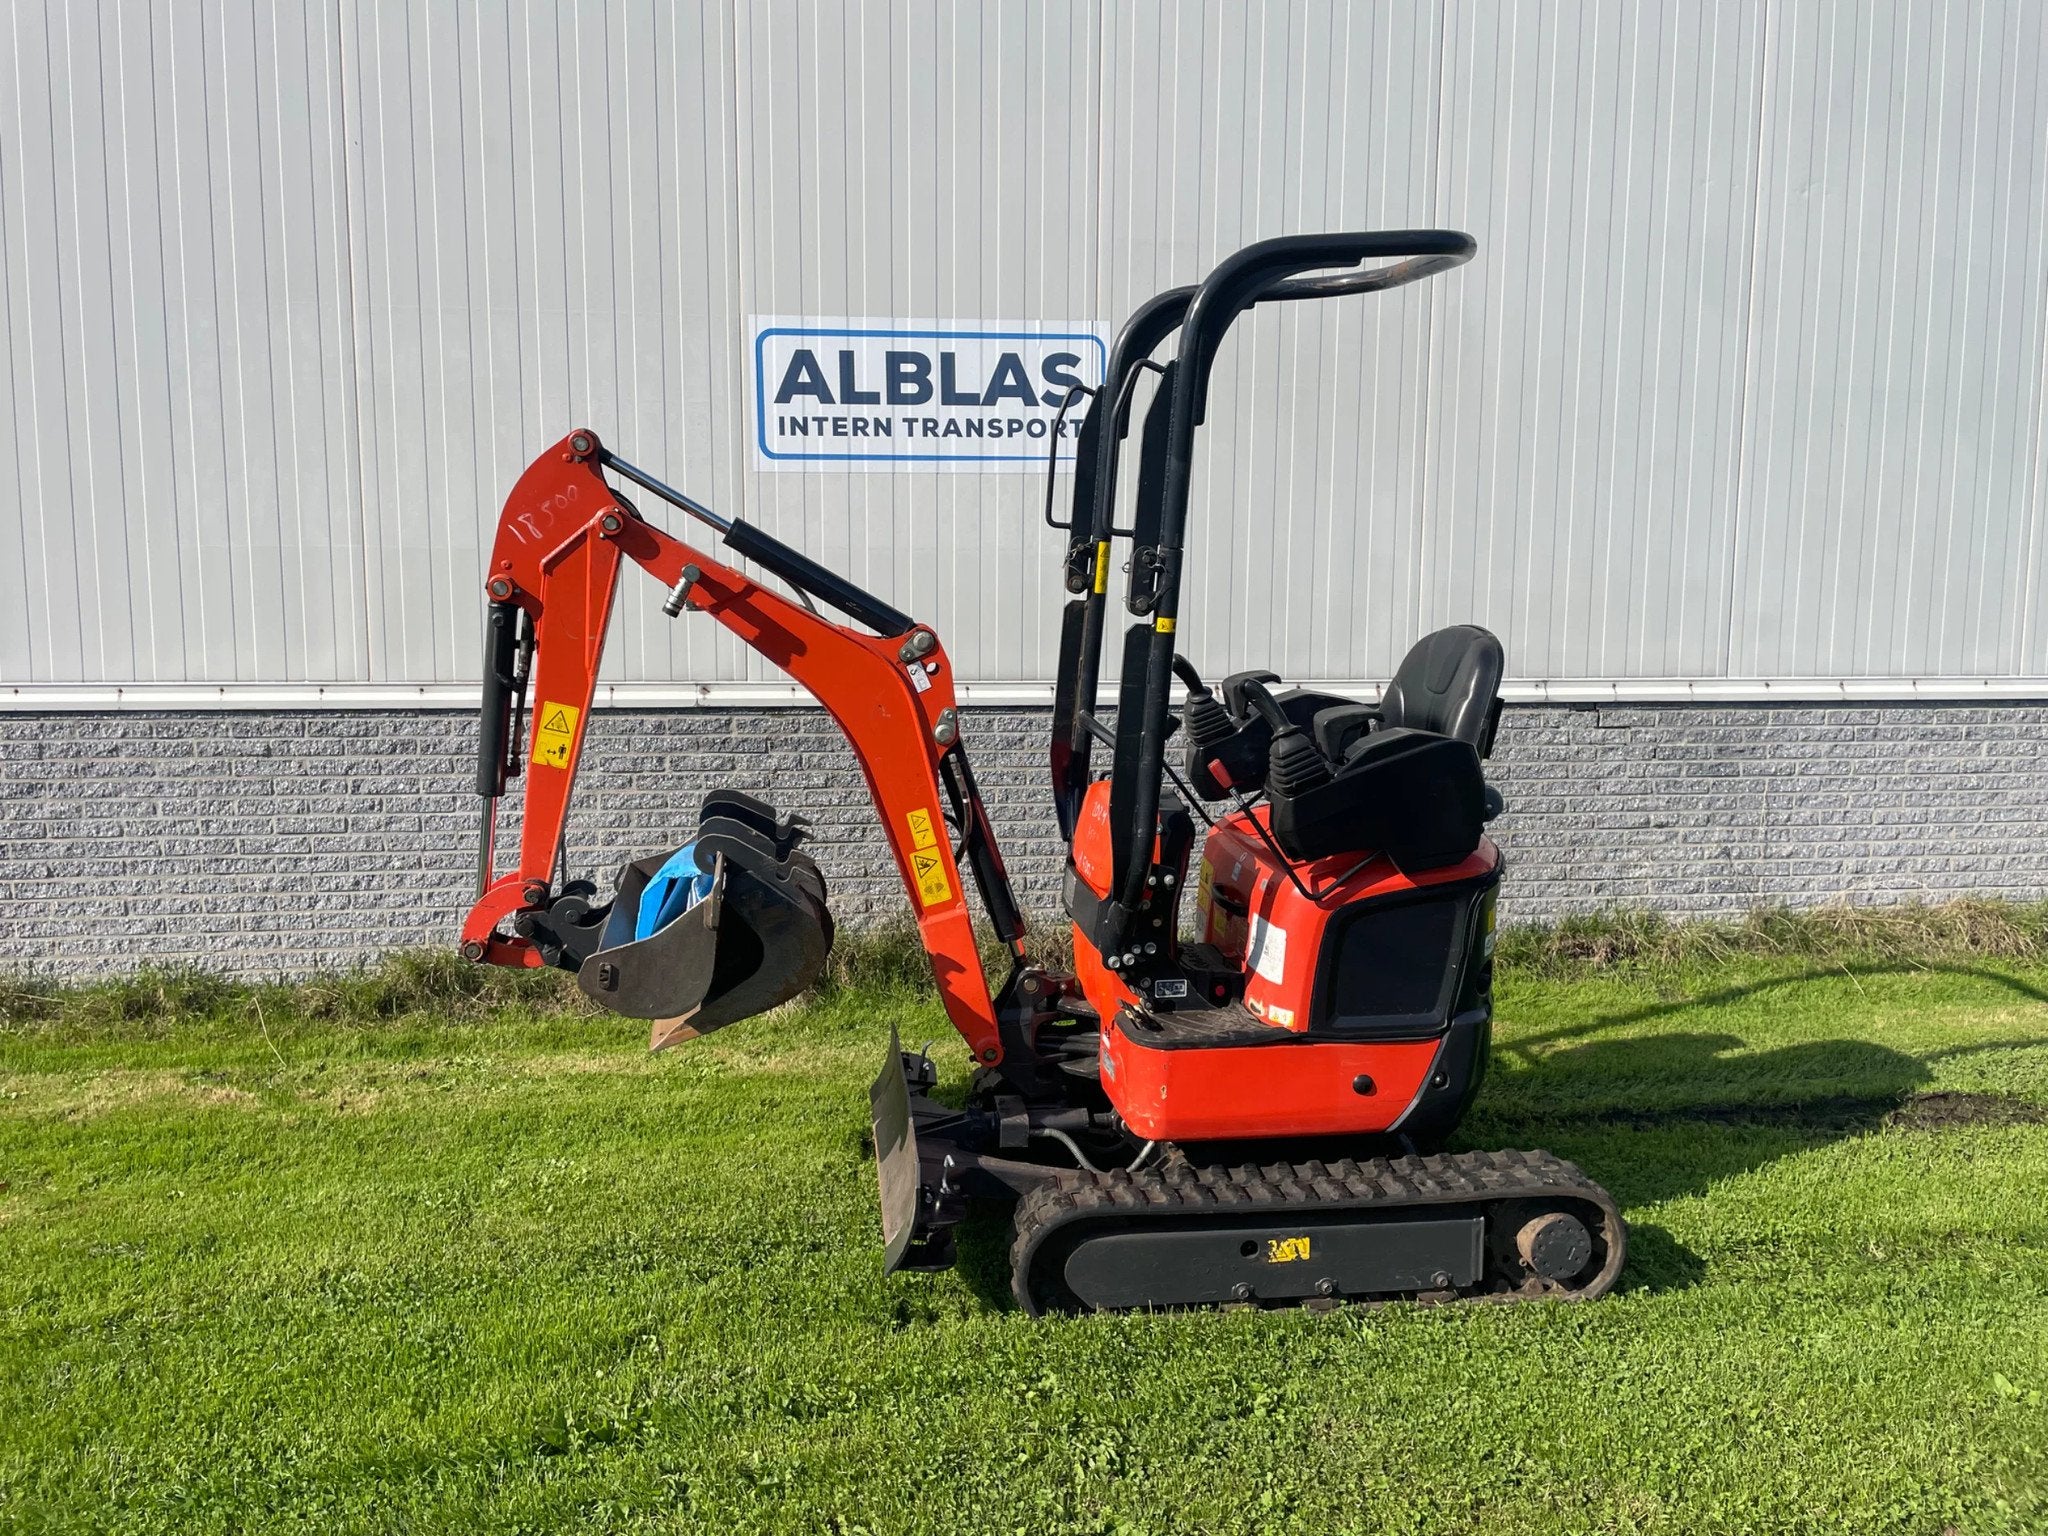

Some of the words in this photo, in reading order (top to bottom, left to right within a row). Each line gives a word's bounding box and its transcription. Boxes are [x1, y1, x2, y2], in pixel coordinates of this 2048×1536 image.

[774, 349, 1085, 408] ALBLAS
[778, 416, 893, 438] INTERN
[902, 417, 1084, 439] TRANSPORT
